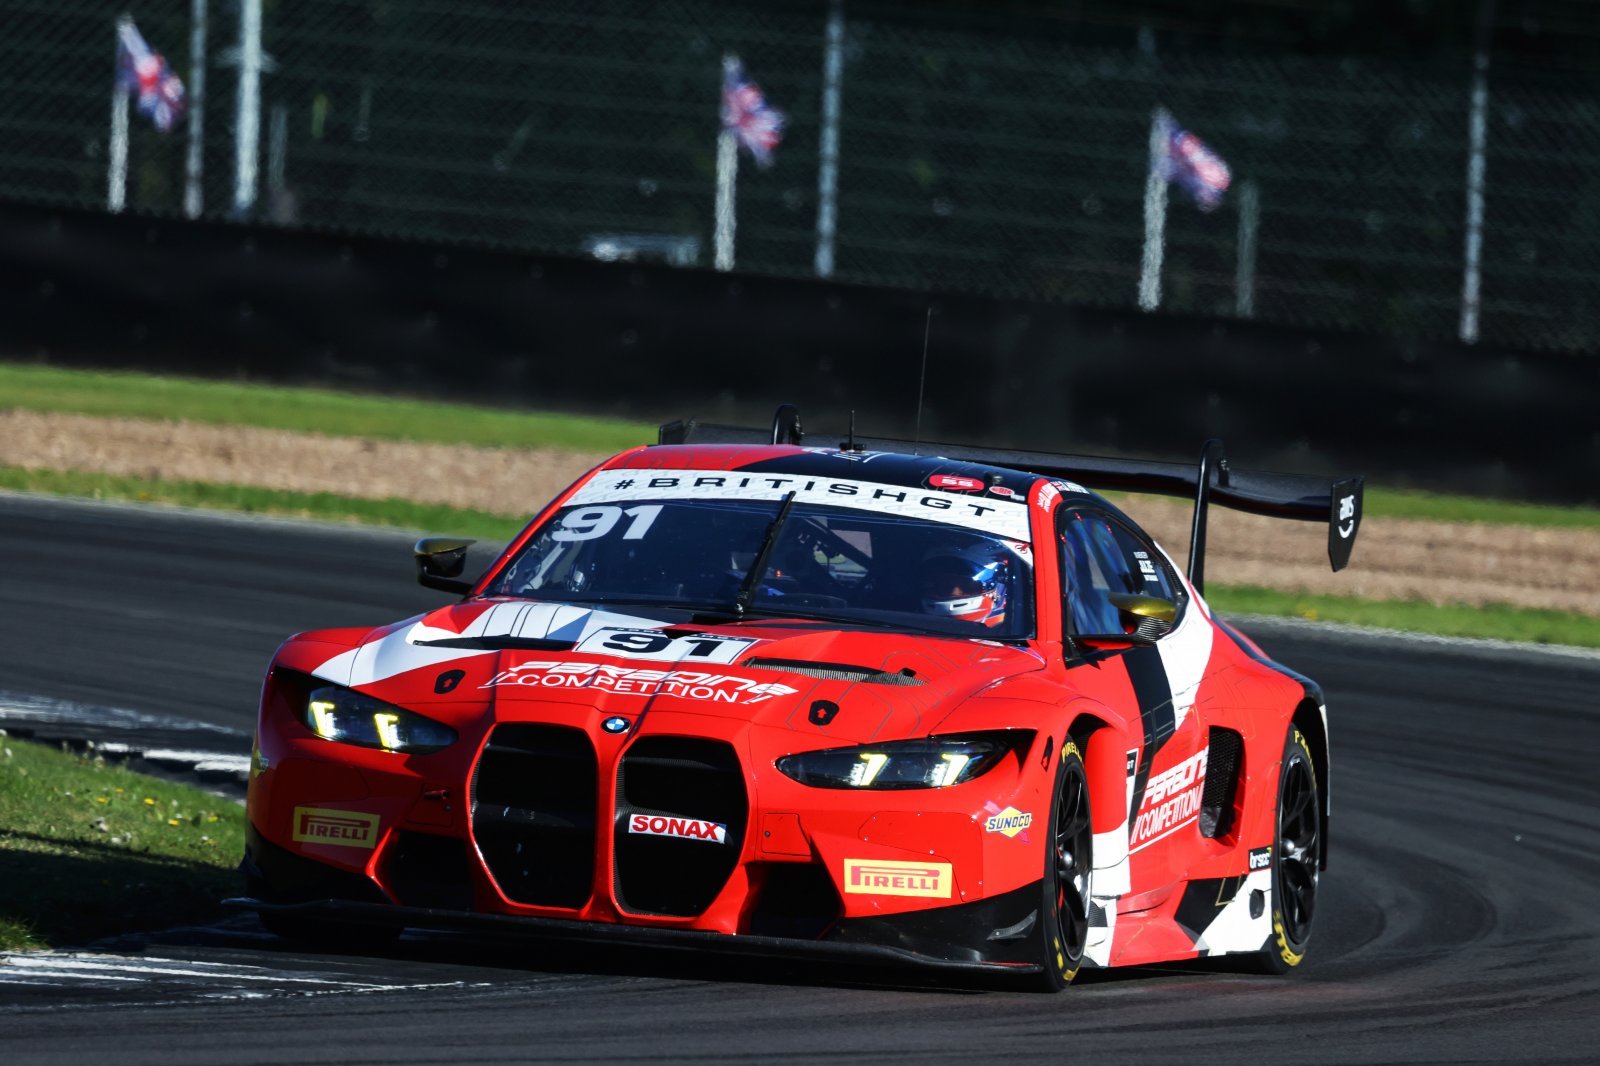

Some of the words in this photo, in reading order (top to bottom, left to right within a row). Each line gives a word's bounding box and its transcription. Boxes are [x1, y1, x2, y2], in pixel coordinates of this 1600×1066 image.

[614, 477, 996, 517] #BRITISHGT
[552, 504, 665, 542] 91
[602, 633, 724, 657] 91
[517, 673, 740, 703] COMPETITION
[300, 813, 372, 841] PIRELLI
[631, 815, 719, 841] SONAX
[988, 814, 1031, 831] SUNOCO
[850, 865, 941, 891] PIRELLI
